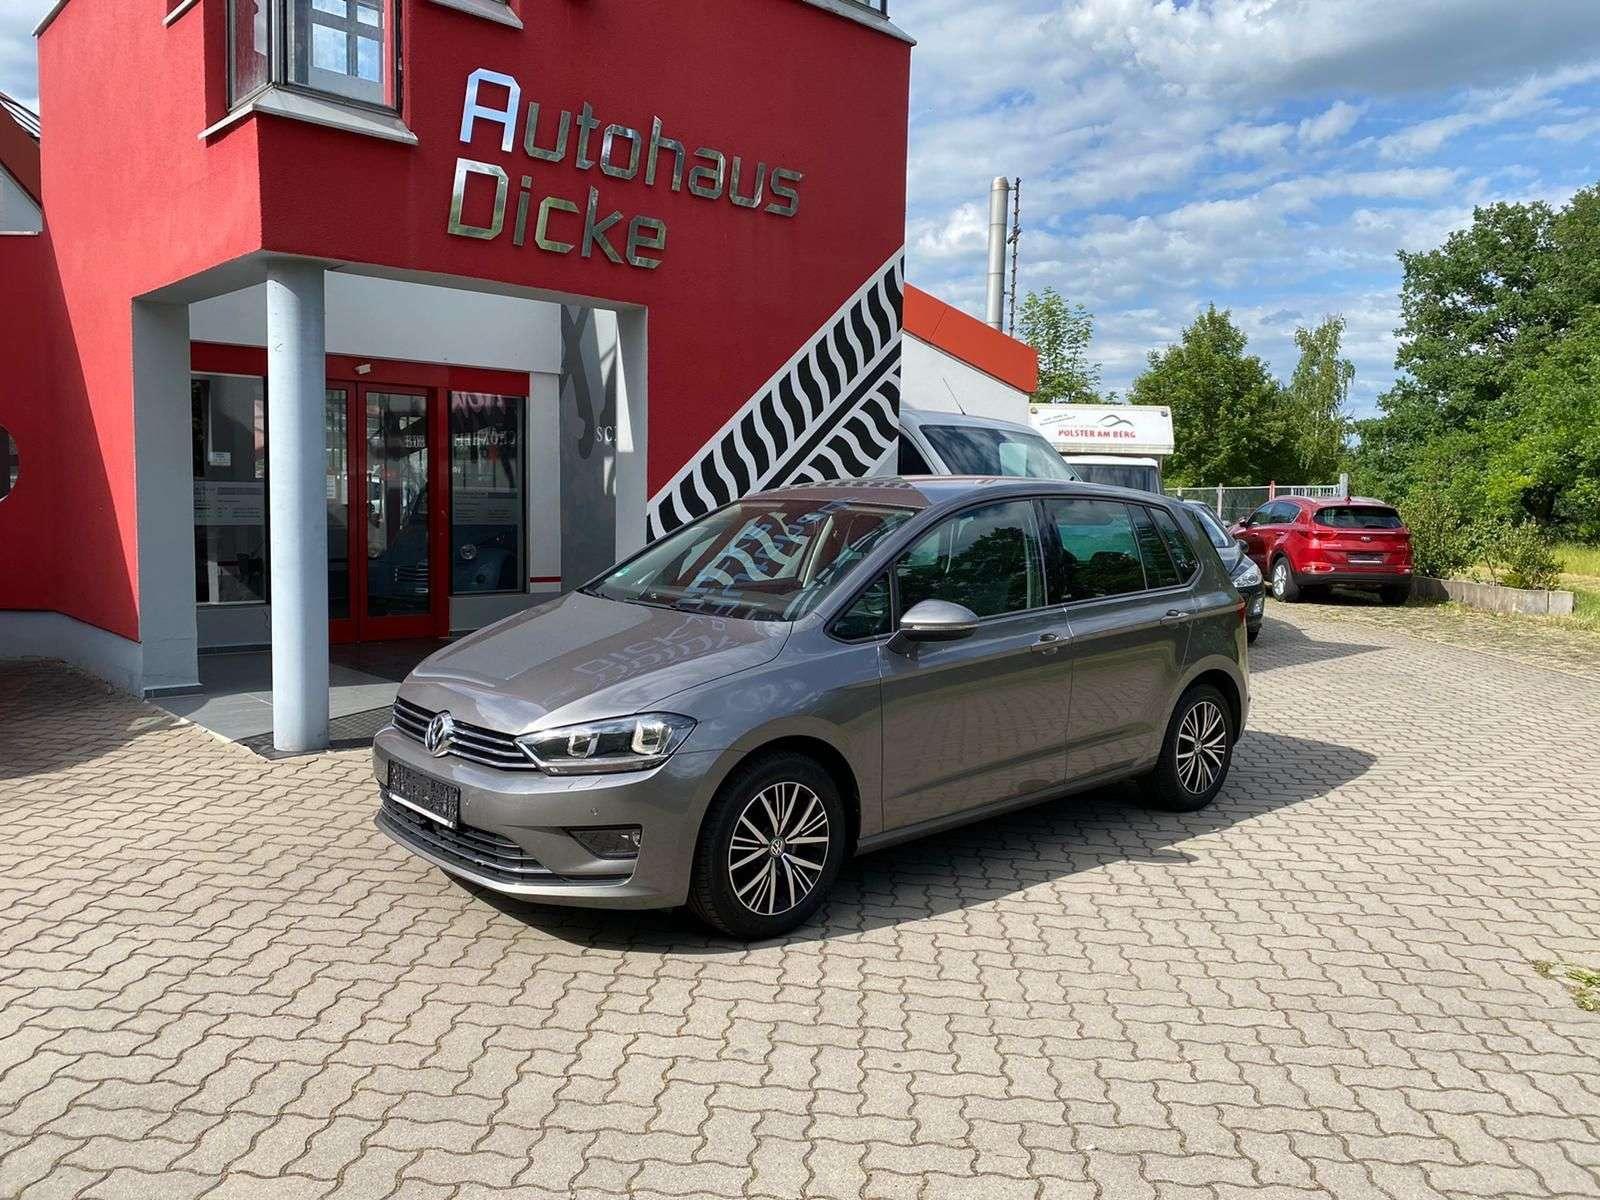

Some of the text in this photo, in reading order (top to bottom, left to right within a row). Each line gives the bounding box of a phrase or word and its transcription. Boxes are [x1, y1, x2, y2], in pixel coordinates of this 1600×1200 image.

[459, 68, 804, 217] Autohaus
[447, 157, 667, 270] Dicke
[596, 426, 617, 442] SC
[1058, 429, 1136, 439] POLSTER AM BERG
